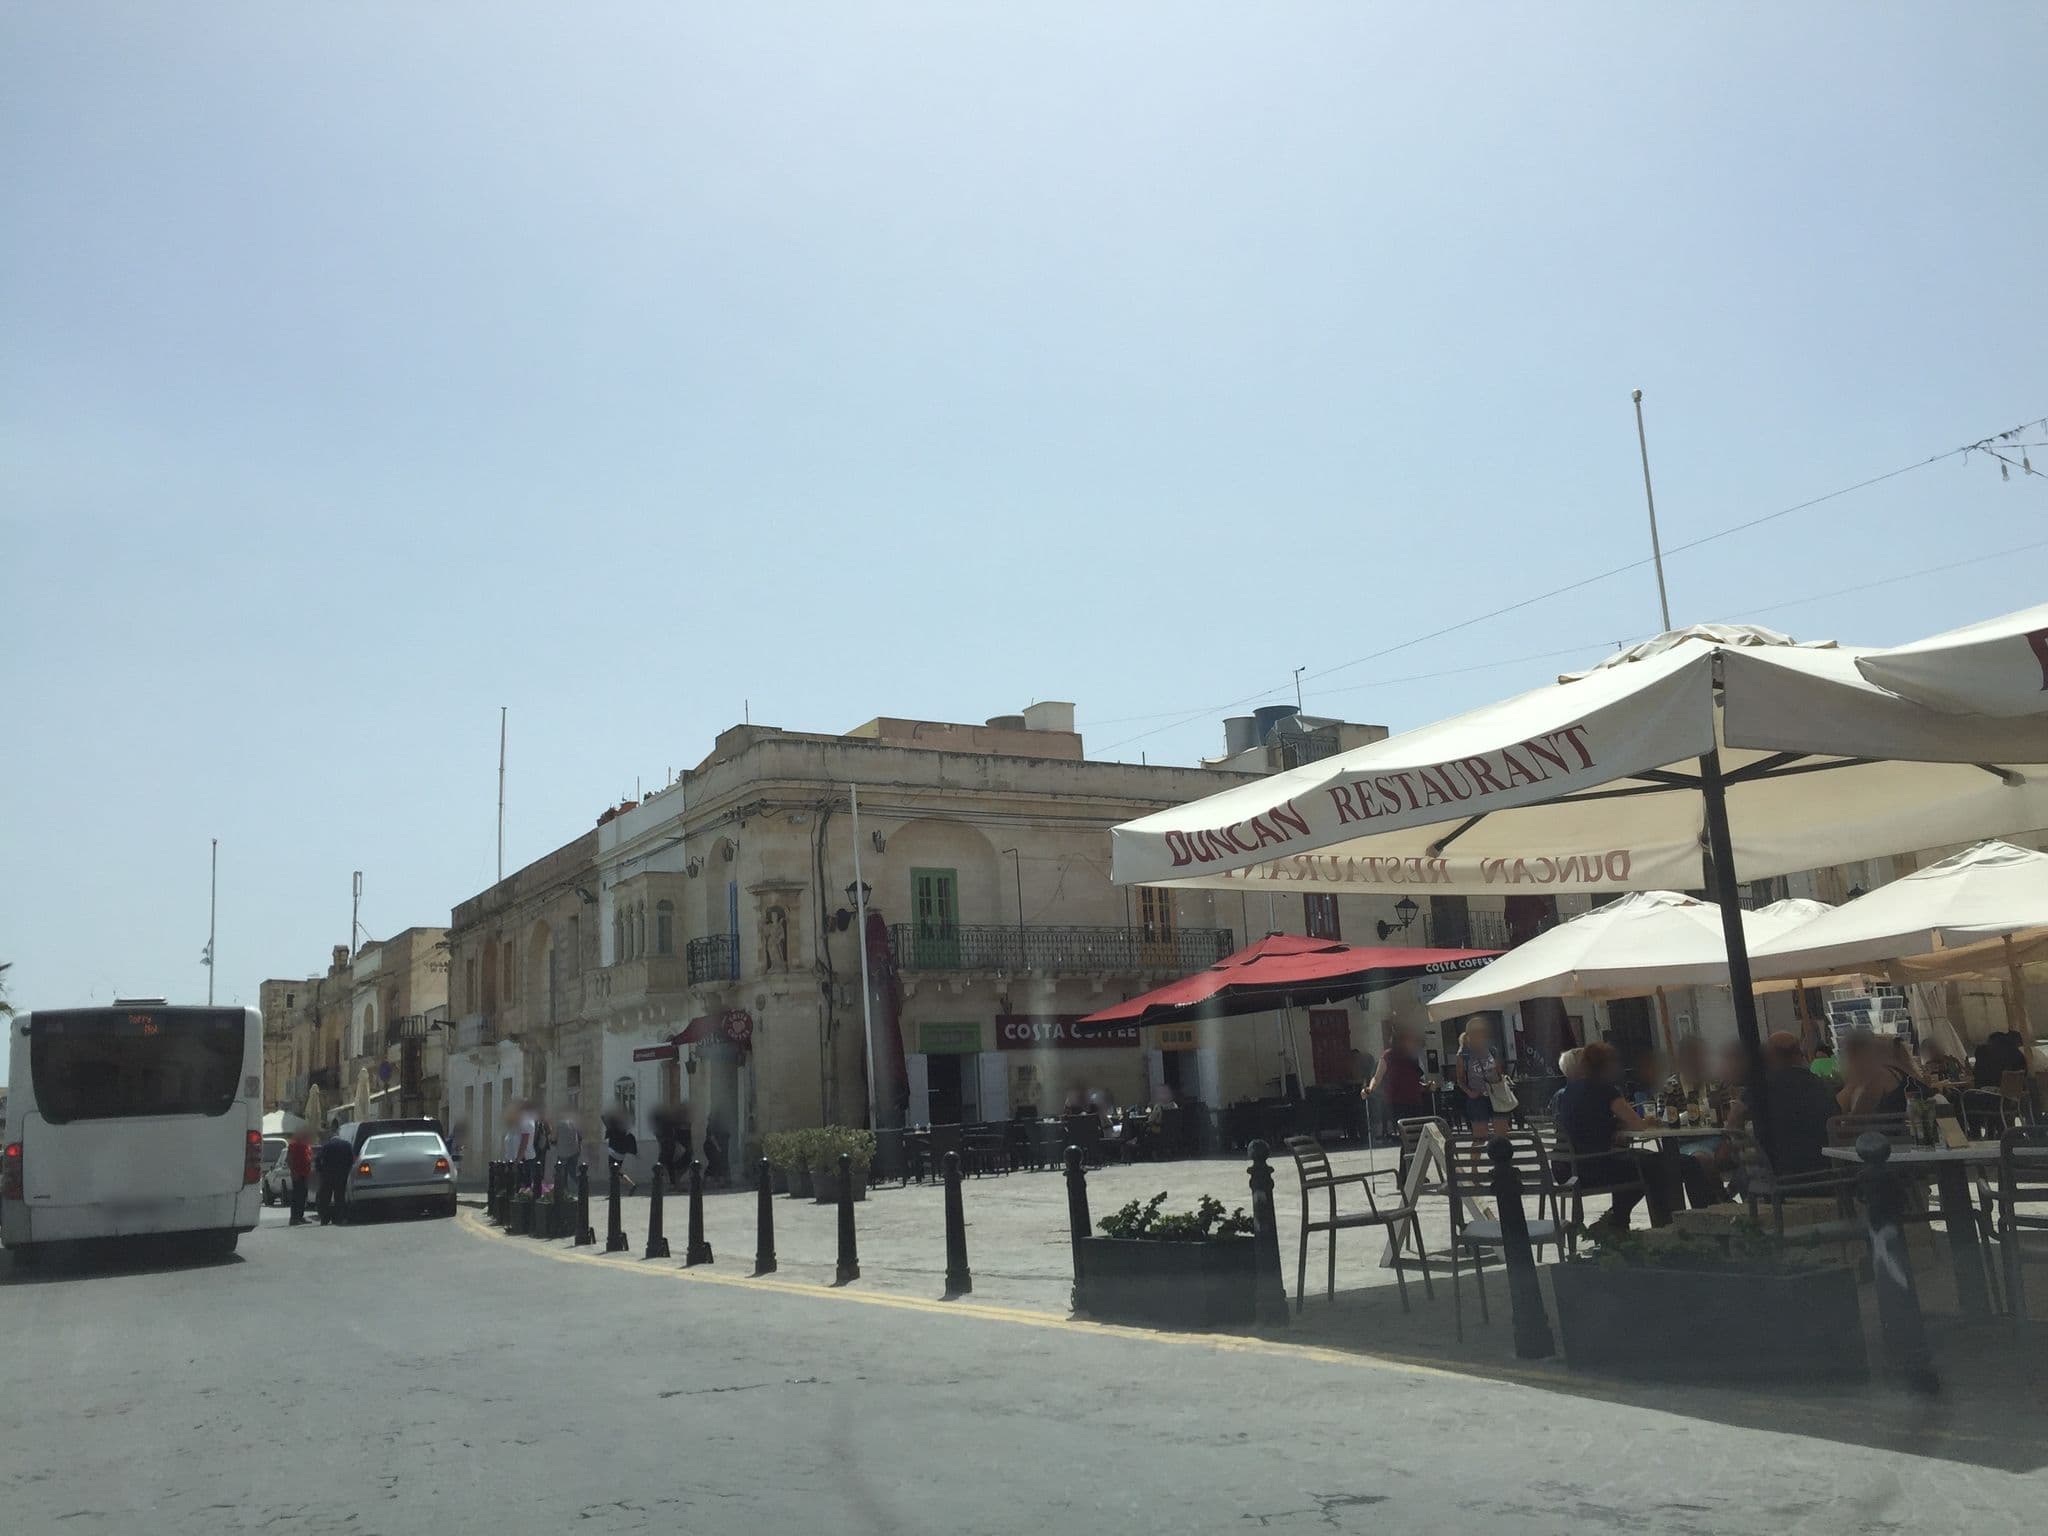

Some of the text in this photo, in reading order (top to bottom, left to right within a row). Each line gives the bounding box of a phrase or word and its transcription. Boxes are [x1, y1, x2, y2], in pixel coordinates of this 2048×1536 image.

[1165, 725, 1597, 866] DUNCAN RESTAURANT
[1425, 961, 1457, 973] COSTA
[1004, 1023, 1066, 1040] COSTA
